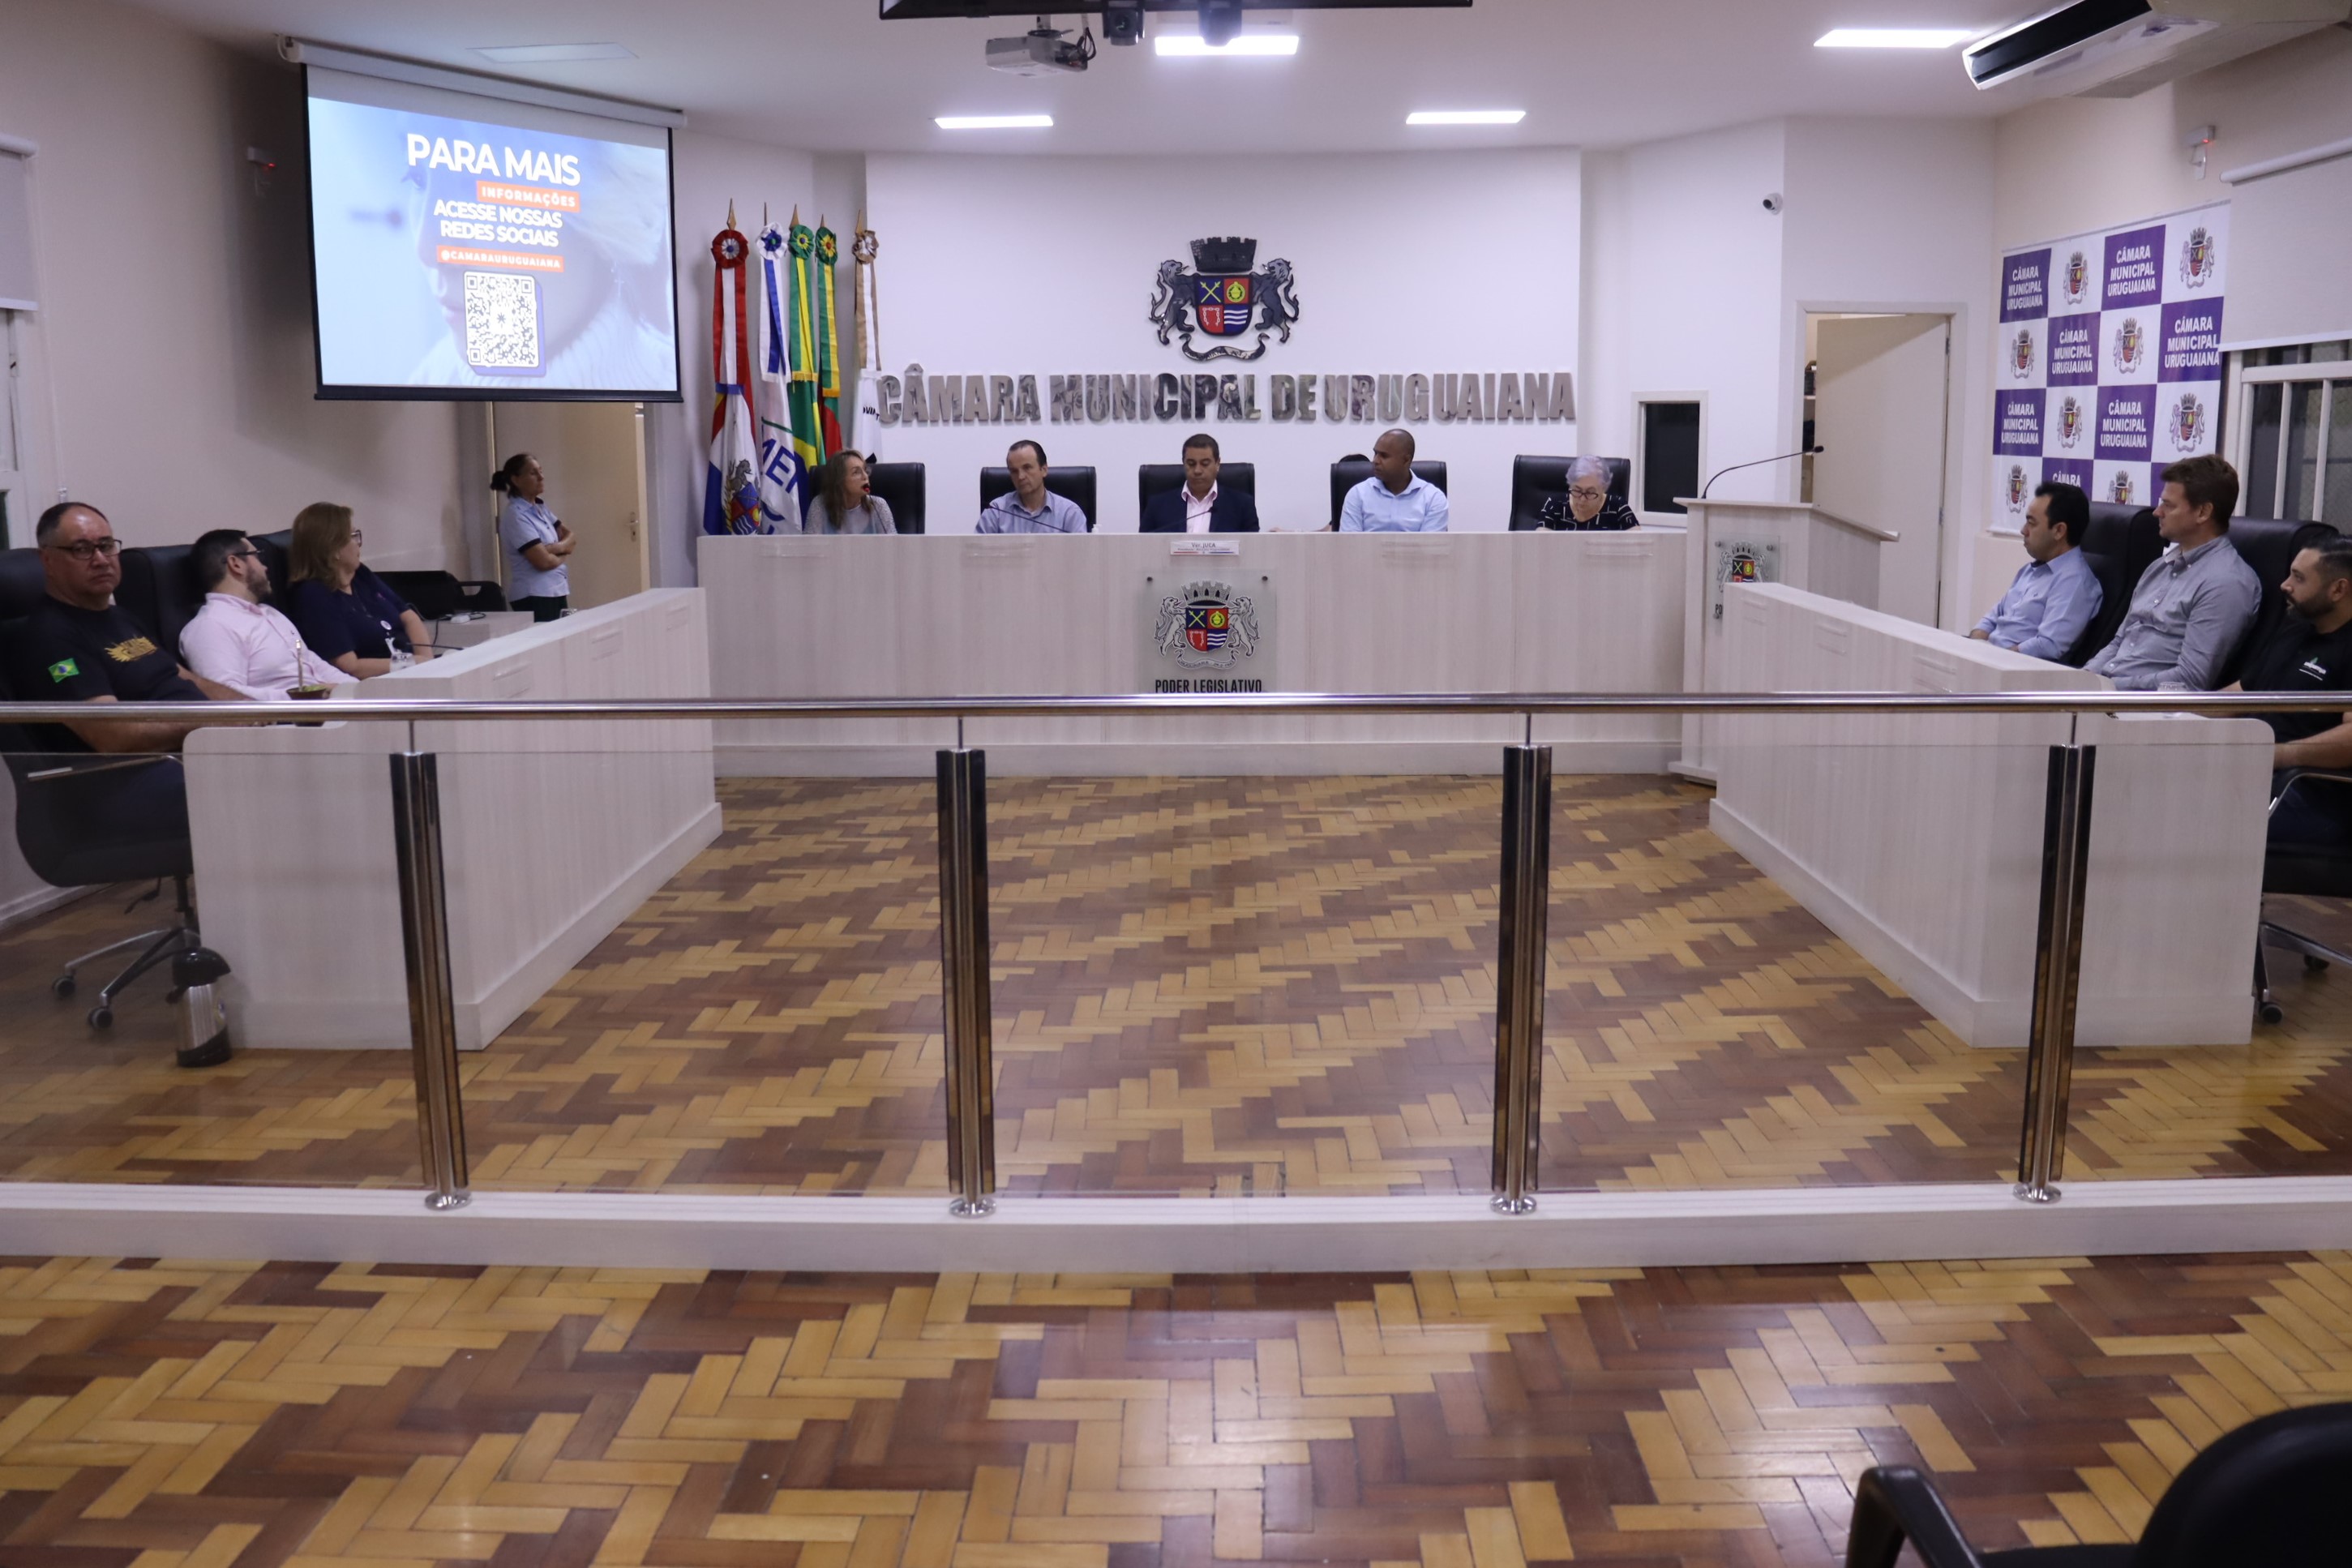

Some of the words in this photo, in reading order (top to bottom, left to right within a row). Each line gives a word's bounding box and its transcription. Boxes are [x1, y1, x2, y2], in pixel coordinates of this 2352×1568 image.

[407, 133, 501, 177] PARA
[504, 147, 581, 186] MAIS
[481, 186, 576, 208] INFORMAÇÕES
[433, 199, 497, 222] ACESSE
[499, 207, 563, 228] NOSSAS
[440, 220, 495, 241] REDES
[496, 225, 559, 247] SOCIAIS
[441, 250, 561, 268] @CAMARAURUGUAIANA
[2116, 245, 2151, 263] CÂMARA
[2110, 261, 2155, 281] MUNICIPAL
[2008, 281, 2041, 297] MUNICIPAL
[2108, 277, 2156, 297] URUGUAIANA
[2174, 315, 2213, 334] CÂMARA
[2059, 328, 2088, 345] CÂMARA
[2167, 334, 2219, 352] MUNICIPAL
[2054, 345, 2092, 360] MUNICIPAL
[2165, 351, 2220, 368] URUGUAIANA
[2052, 360, 2093, 375] URUGUAIANA
[877, 363, 1041, 426] CÂMARA
[1049, 372, 1262, 422] MUNICIPAL
[1270, 374, 1317, 421] DE
[1324, 372, 1575, 422] URUGUAIANA
[2108, 399, 2142, 415] CÂMARA
[2003, 418, 2038, 431] MUNICIPAL
[2102, 418, 2147, 432] MUNICIPAL
[2100, 434, 2147, 448] URUGUAIANA
[1155, 679, 1189, 693] PODER
[1193, 679, 1262, 693] LEGISLATIVO
